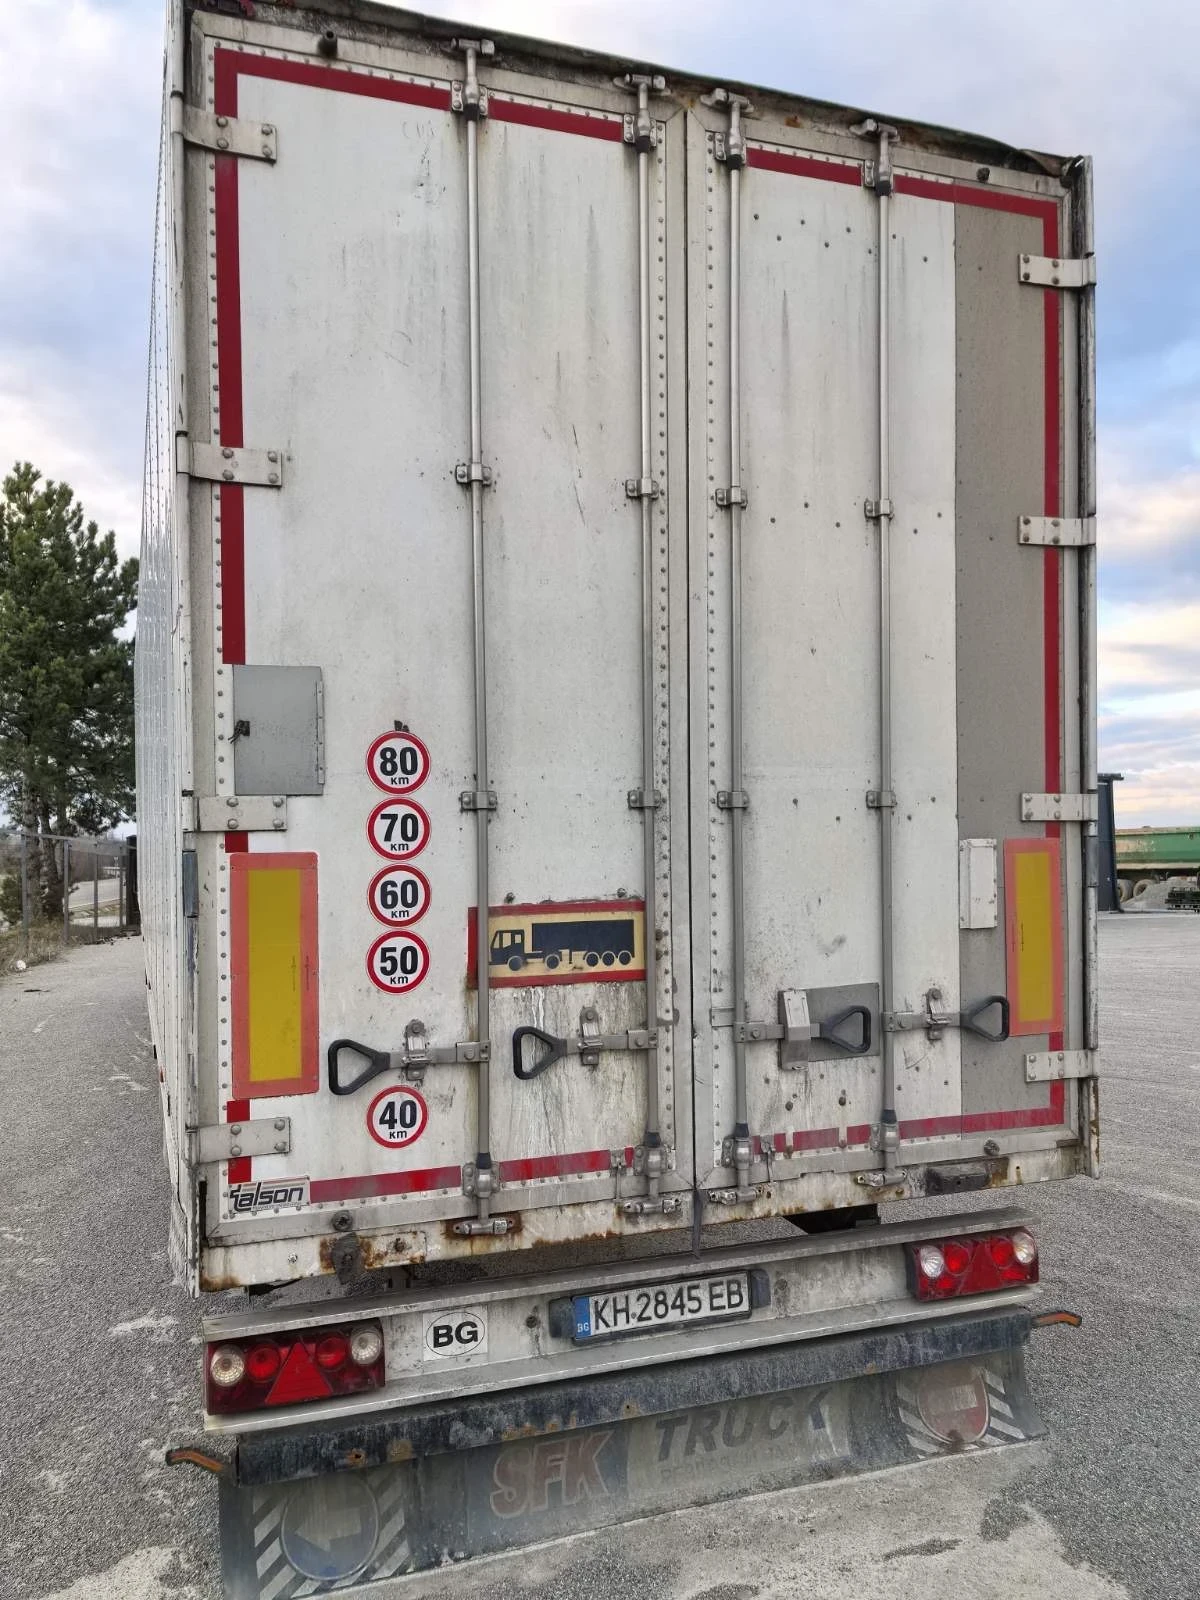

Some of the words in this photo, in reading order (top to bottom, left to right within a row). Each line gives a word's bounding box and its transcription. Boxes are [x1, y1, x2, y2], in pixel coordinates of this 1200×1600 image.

[380, 747, 418, 776] 80
[380, 813, 419, 842] 70
[380, 879, 419, 909] 60
[380, 946, 418, 976] 50
[379, 1100, 417, 1130] 40
[229, 1182, 303, 1212] talson
[636, 1284, 702, 1323] 2845
[708, 1278, 744, 1312] EB
[433, 1321, 479, 1349] BG
[577, 1322, 590, 1333] BG
